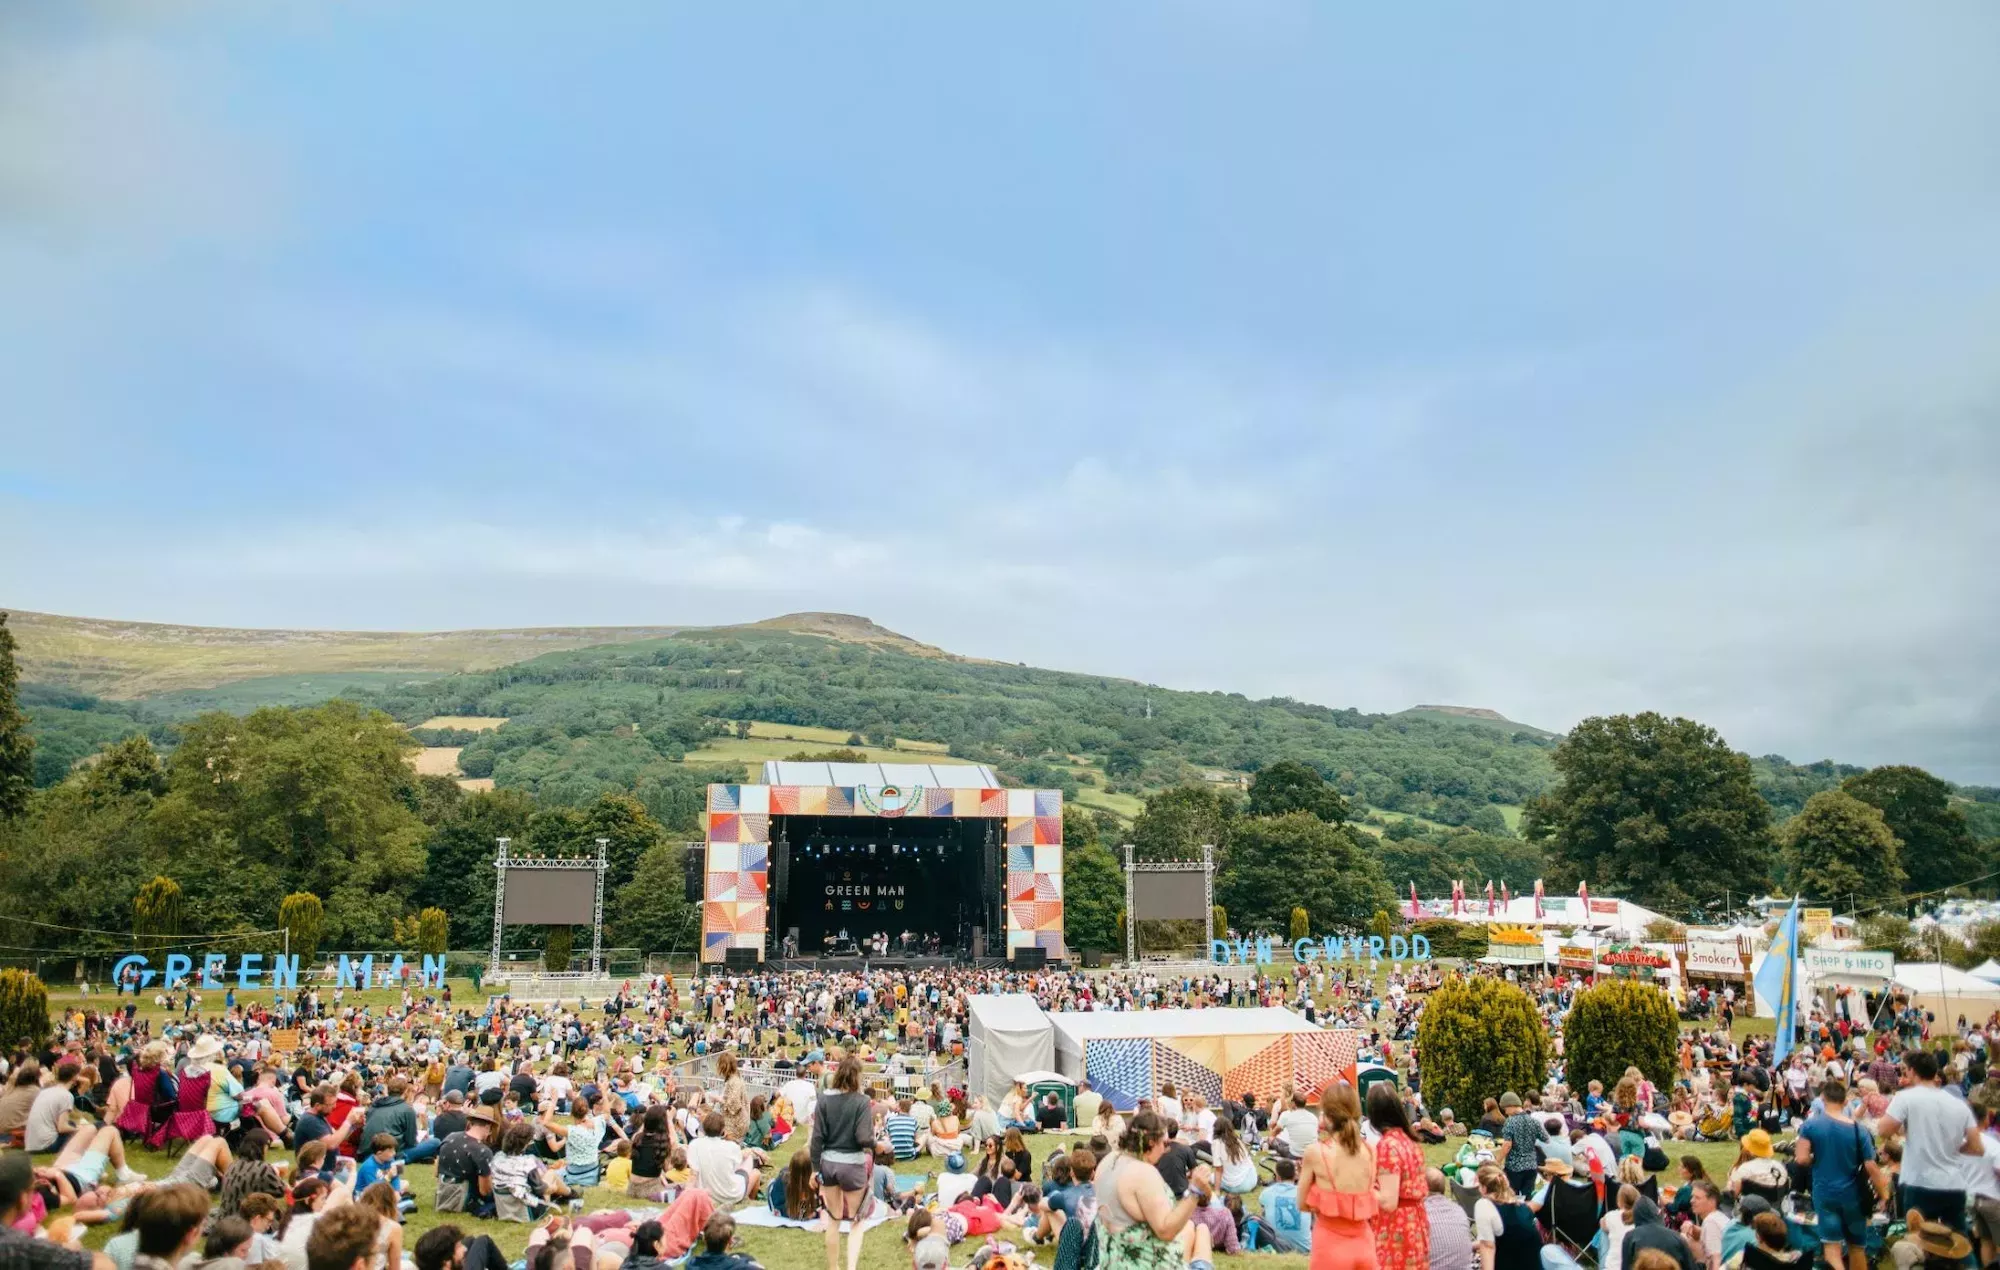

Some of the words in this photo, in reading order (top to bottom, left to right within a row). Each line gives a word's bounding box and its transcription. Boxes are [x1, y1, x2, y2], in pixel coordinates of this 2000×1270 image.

[825, 885, 870, 896] GREEN
[877, 885, 905, 896] MAN
[1211, 937, 1272, 965] DYN
[1292, 934, 1431, 964] GWYRDD
[1606, 953, 1630, 964] PASTA
[1635, 953, 1659, 966] PIZZA
[1692, 950, 1738, 967] Smokery
[1845, 959, 1853, 969] &
[1857, 958, 1884, 970] INFO
[112, 953, 300, 992] GREEN
[336, 953, 446, 990] MAN
